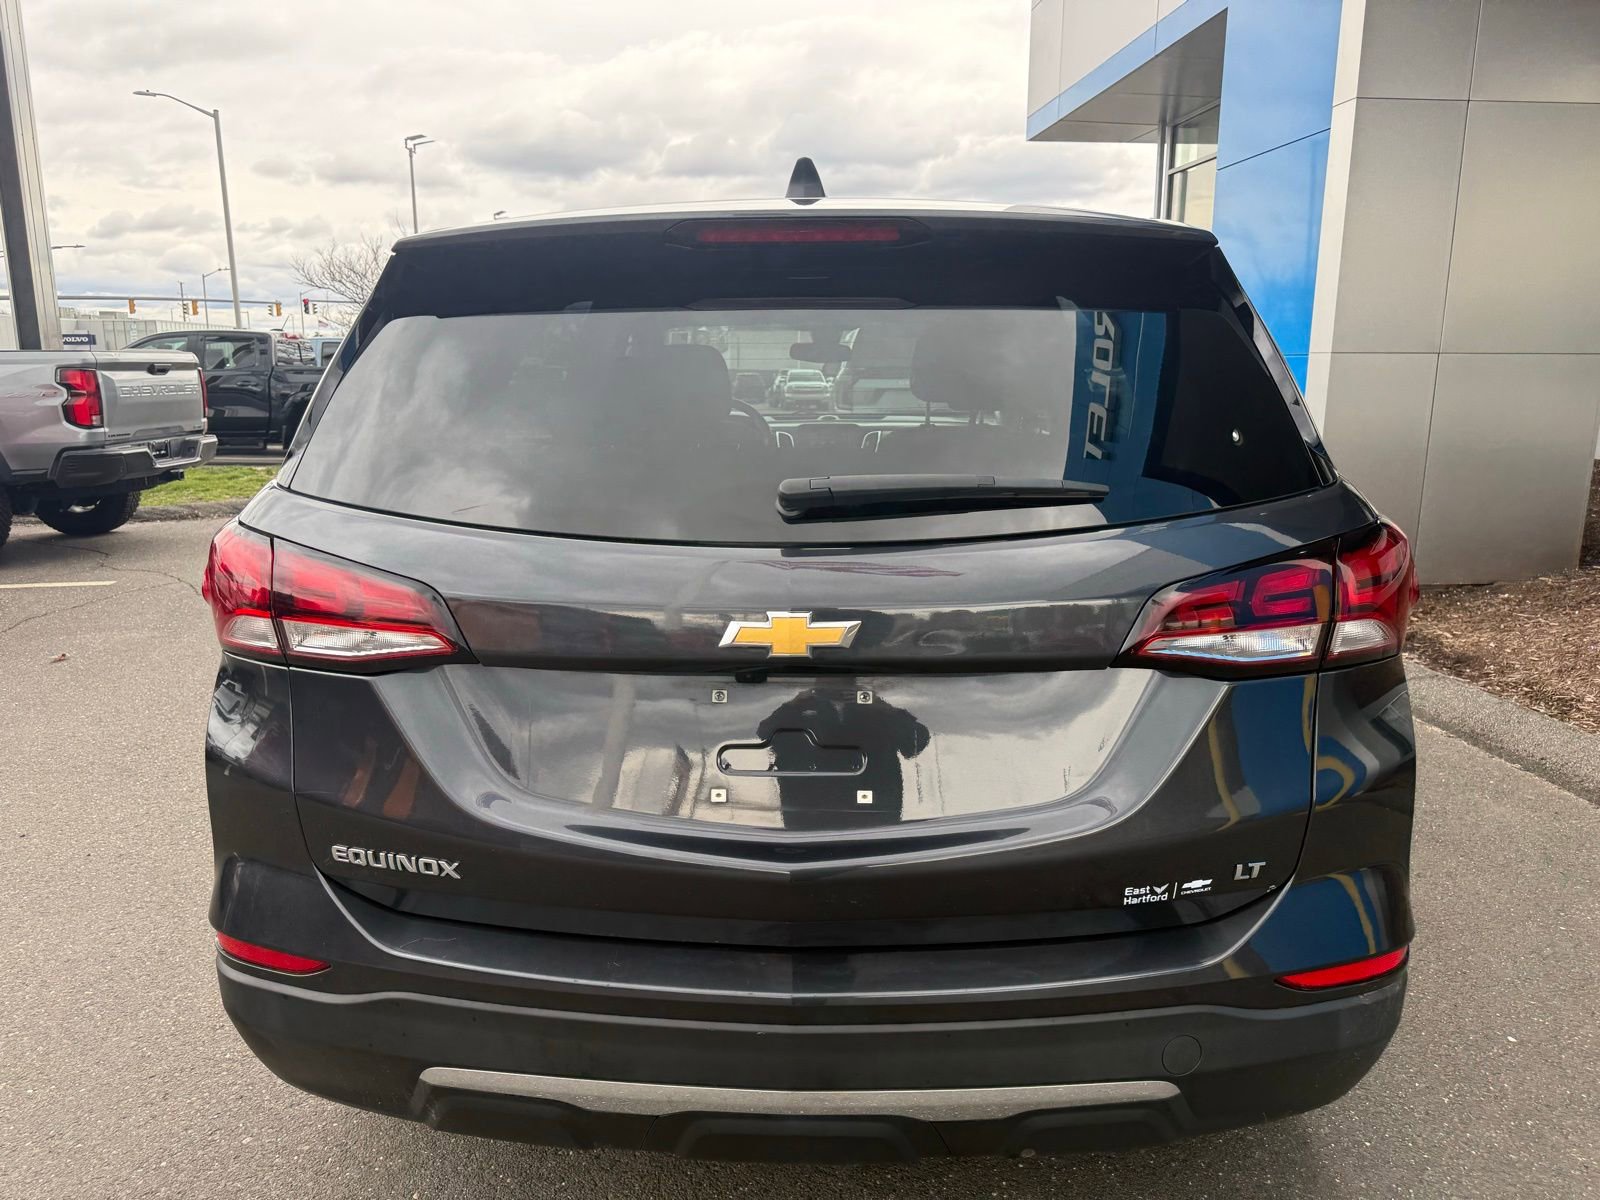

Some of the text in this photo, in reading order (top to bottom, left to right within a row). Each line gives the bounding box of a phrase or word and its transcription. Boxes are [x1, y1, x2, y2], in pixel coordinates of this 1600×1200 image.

[120, 384, 199, 397] CHEVROLET
[331, 844, 462, 879] EQUINOX
[1234, 862, 1266, 880] LT
[1124, 885, 1150, 896] East
[1123, 892, 1169, 906] Hartford
